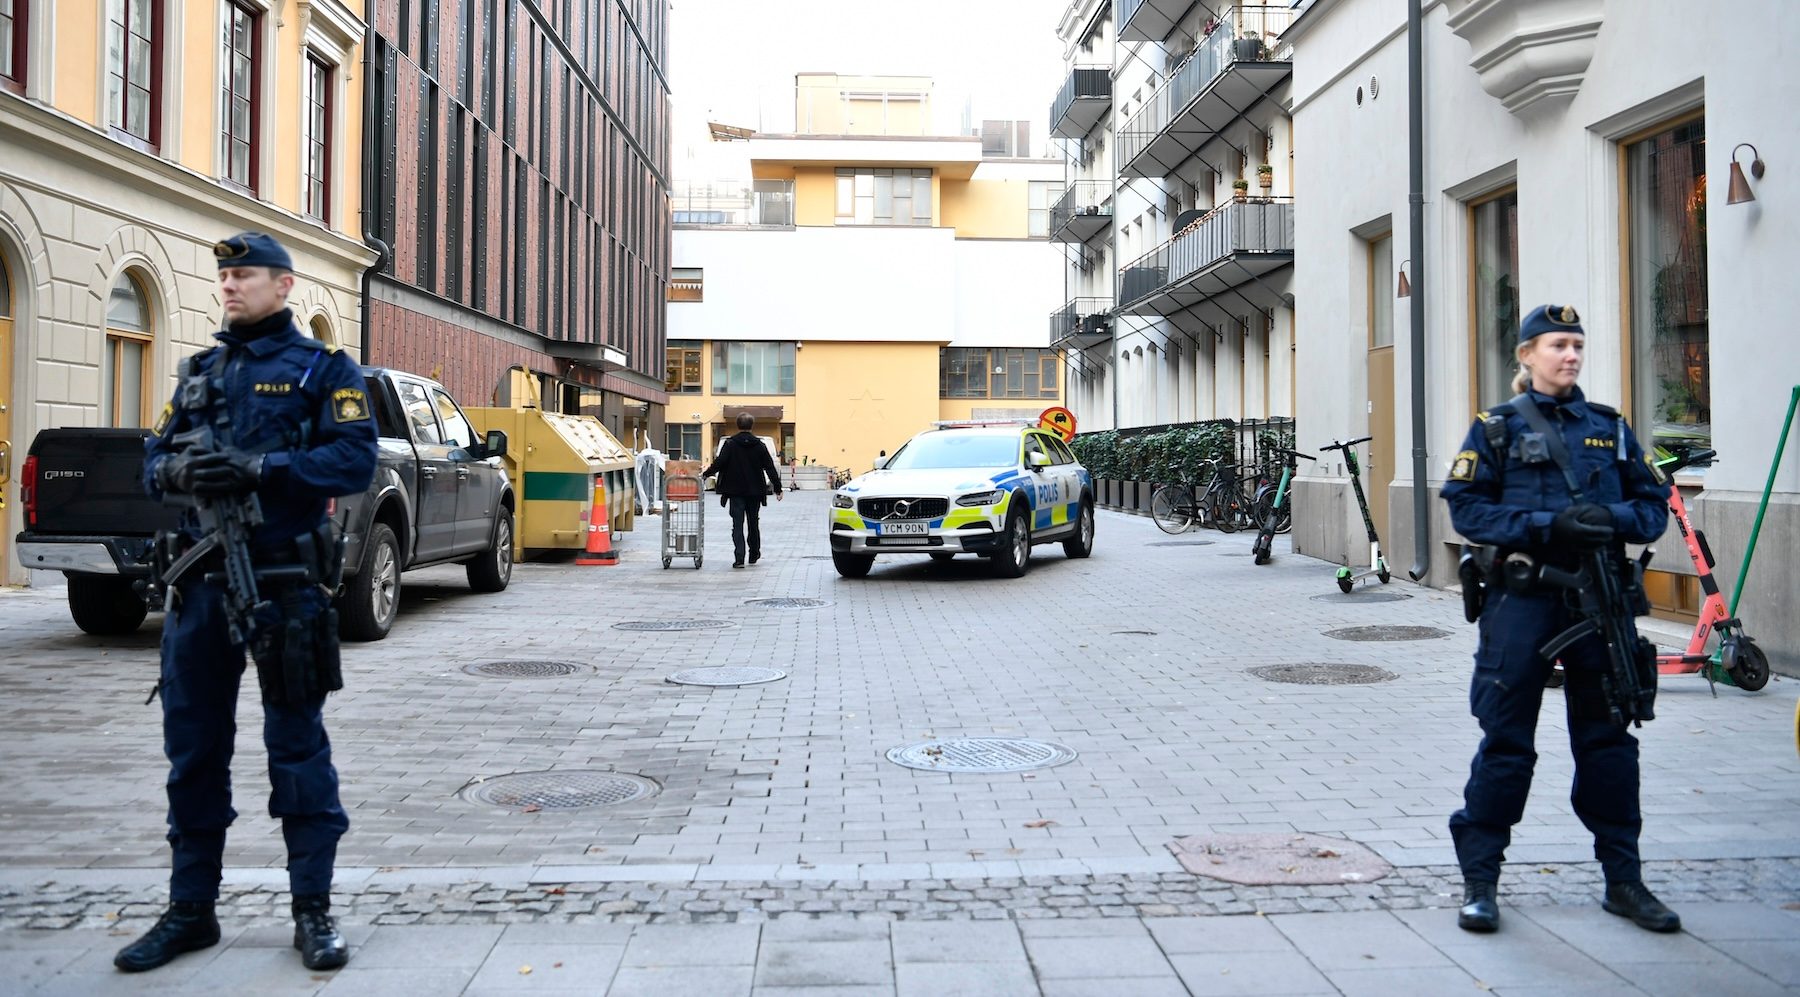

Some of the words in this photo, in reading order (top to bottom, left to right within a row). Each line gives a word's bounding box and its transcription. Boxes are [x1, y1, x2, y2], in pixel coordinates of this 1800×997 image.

[255, 384, 290, 392] POLIS
[335, 389, 363, 400] POLIS
[1584, 438, 1613, 447] POLIS
[1038, 483, 1058, 504] POLIS
[884, 524, 903, 533] YCM
[905, 523, 924, 533] 90N
